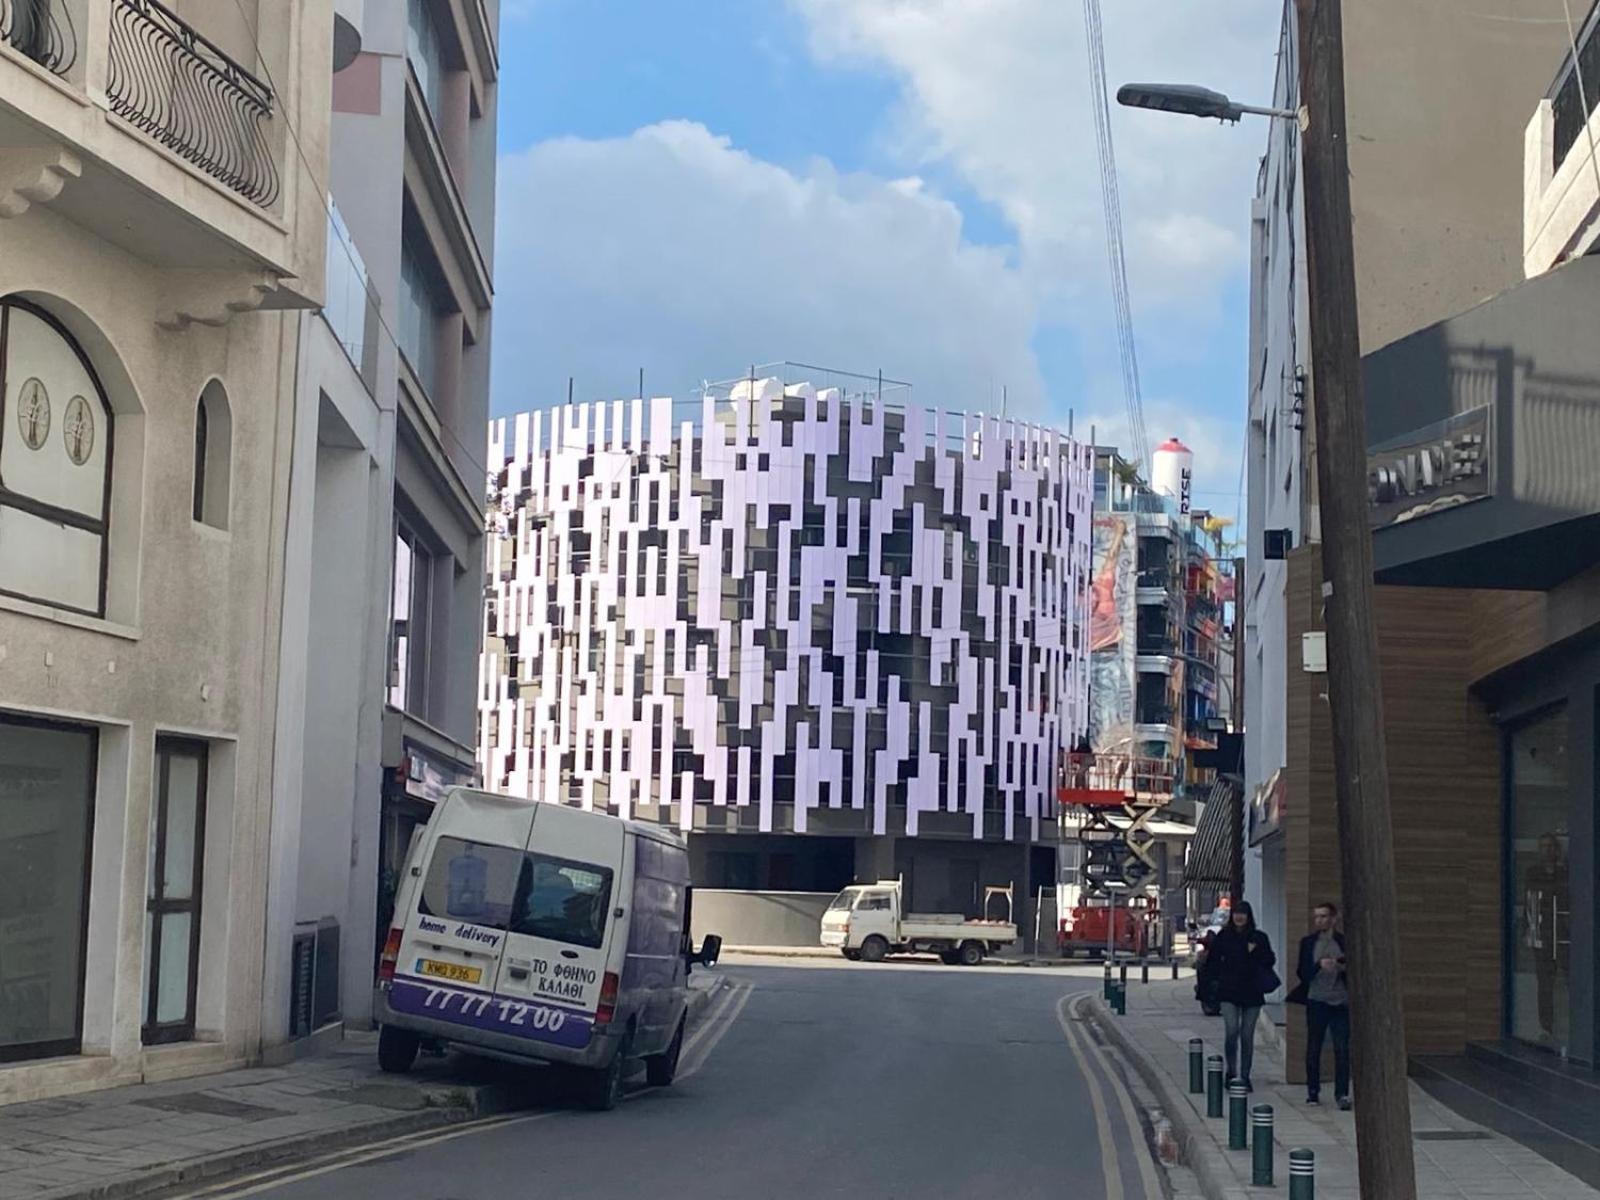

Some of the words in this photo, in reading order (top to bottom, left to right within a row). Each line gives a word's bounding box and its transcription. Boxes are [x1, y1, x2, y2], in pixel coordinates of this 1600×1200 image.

[1180, 467, 1191, 515] RISE
[418, 916, 447, 934] home
[454, 924, 500, 948] delivery
[538, 977, 583, 999] ΚΑΛΑΘΙ
[554, 963, 596, 984] ΦΘΗΝΟ
[425, 986, 456, 1009] 77
[460, 992, 492, 1017] 77
[499, 999, 529, 1025] 12
[533, 1006, 566, 1032] 00
